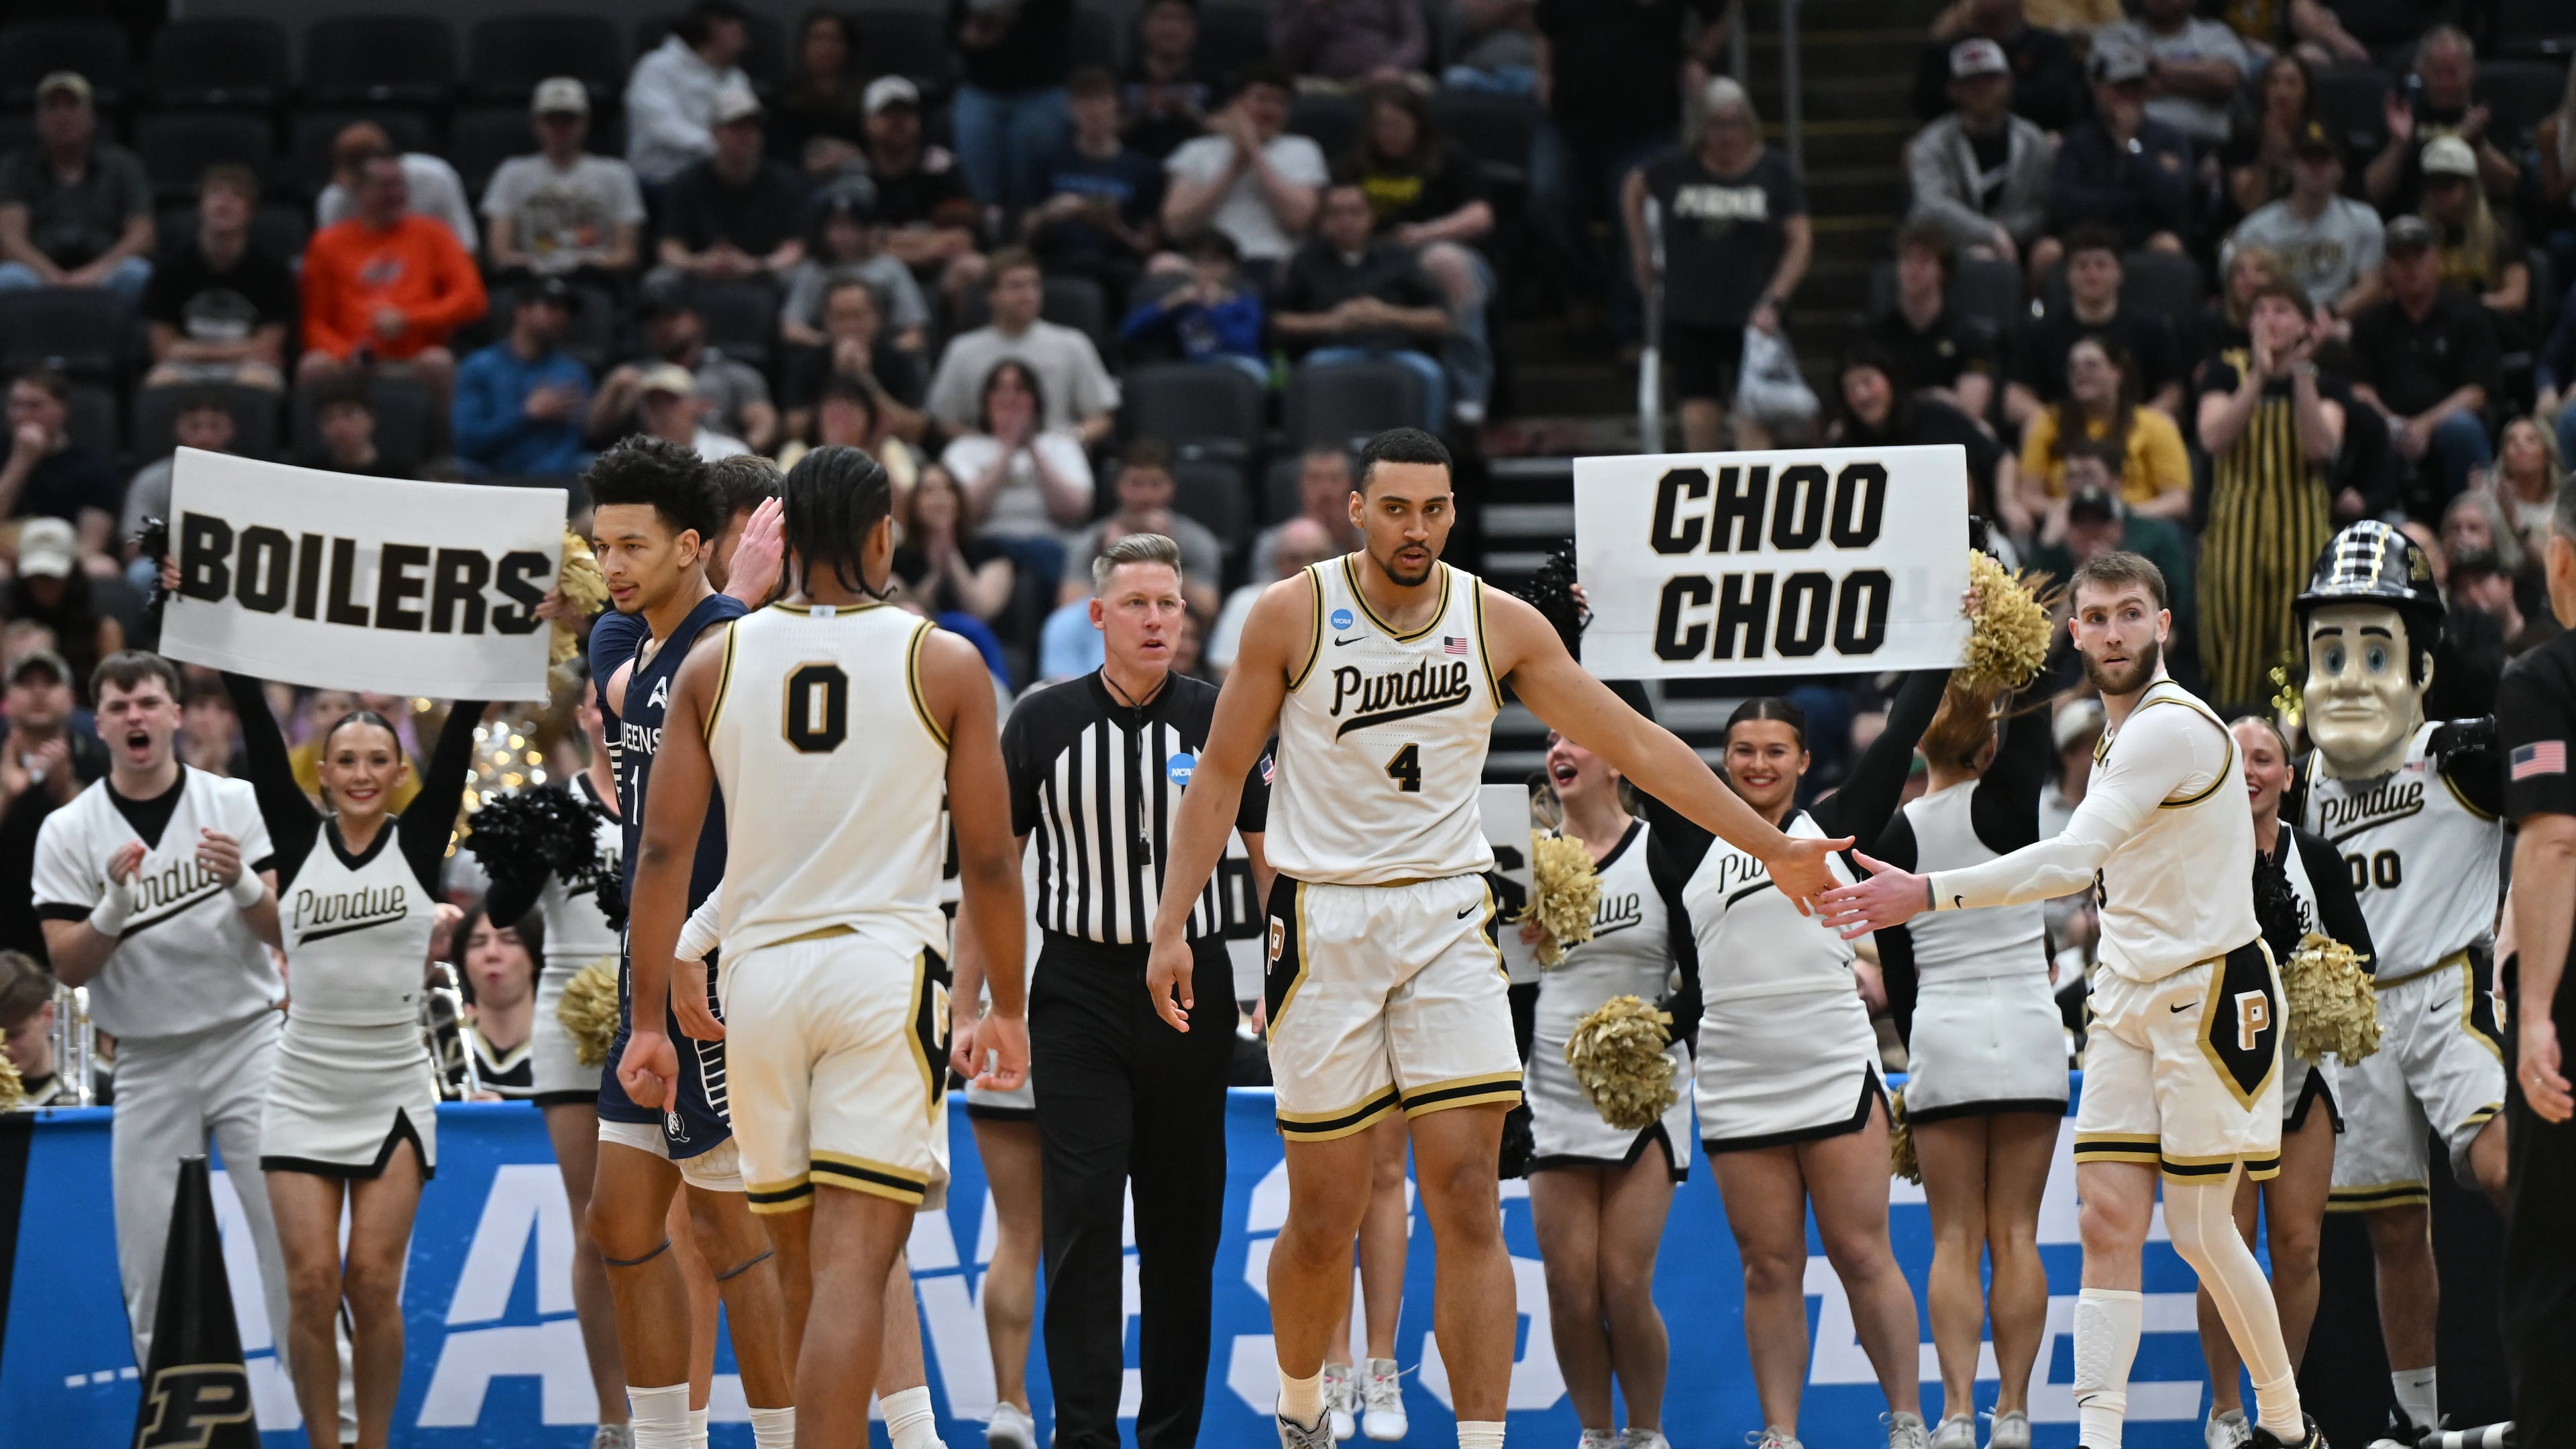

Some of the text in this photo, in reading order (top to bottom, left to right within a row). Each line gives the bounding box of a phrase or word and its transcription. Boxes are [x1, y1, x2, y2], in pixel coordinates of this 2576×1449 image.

[1648, 462, 1889, 556] CHOO
[178, 512, 551, 635] BOILERS
[1652, 567, 1894, 663] CHOO
[782, 661, 849, 754] 0
[1330, 655, 1470, 716] Purdue
[621, 720, 662, 755] UEENS
[1385, 743, 1422, 792] 4
[631, 765, 639, 826] 1
[1171, 767, 1194, 777] NCA
[2318, 781, 2426, 837] Purdue
[2344, 849, 2402, 892] 00
[294, 884, 408, 930] Purdue
[2234, 989, 2270, 1051] P
[136, 1363, 253, 1449] P
